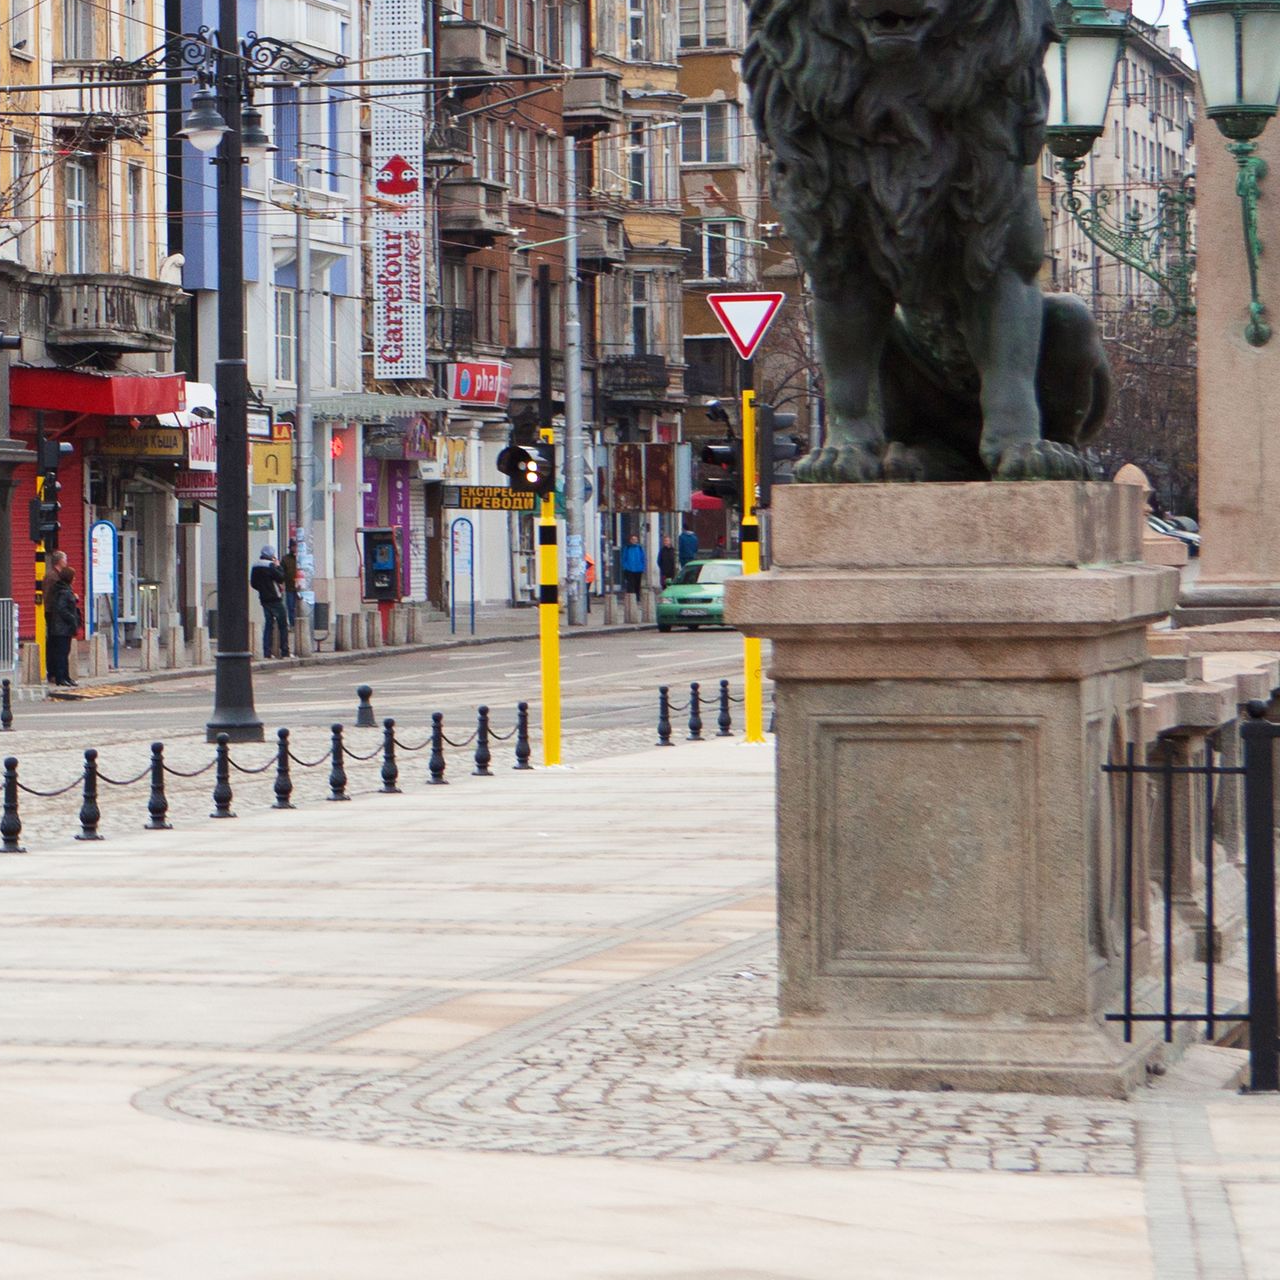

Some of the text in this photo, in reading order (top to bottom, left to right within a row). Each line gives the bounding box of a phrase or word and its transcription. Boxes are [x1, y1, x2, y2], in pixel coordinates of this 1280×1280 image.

[377, 230, 404, 364] Carrefour
[407, 229, 422, 303] market
[461, 497, 534, 510] ПРЕВОДИ
